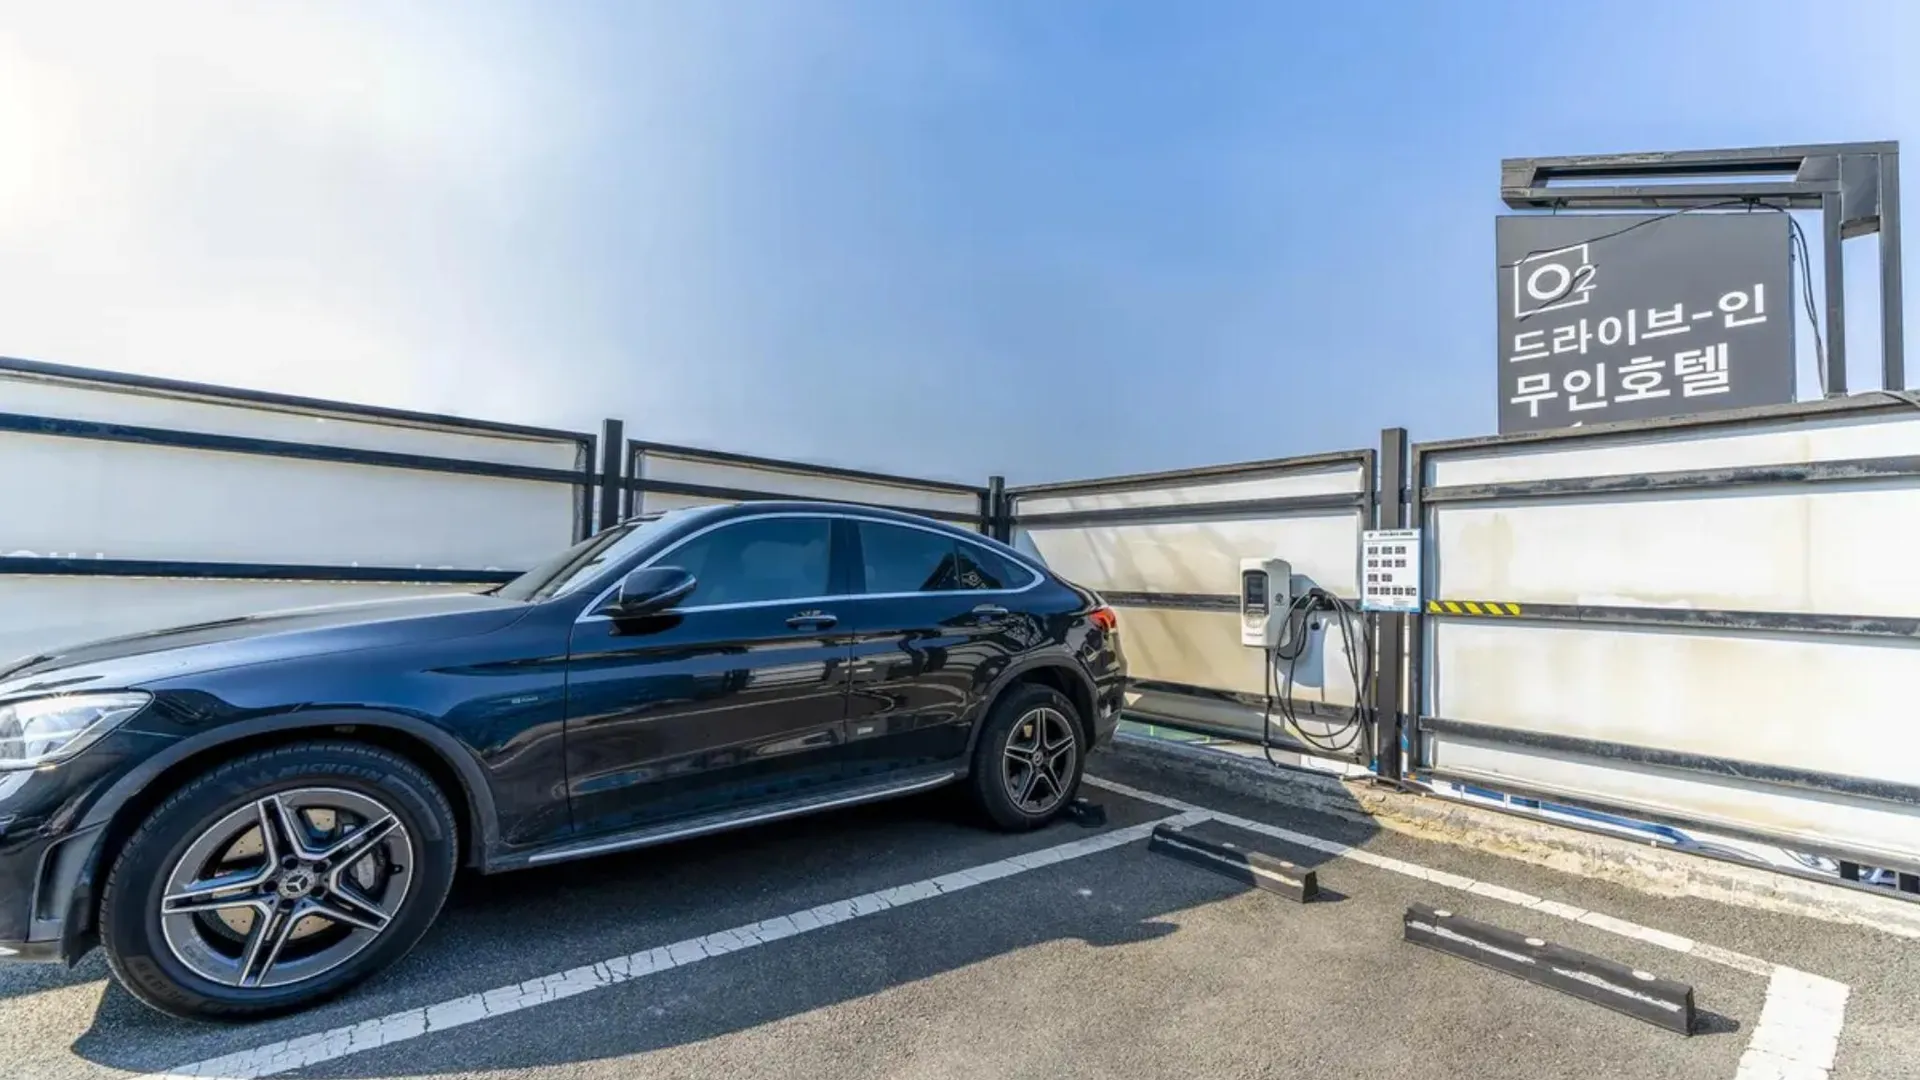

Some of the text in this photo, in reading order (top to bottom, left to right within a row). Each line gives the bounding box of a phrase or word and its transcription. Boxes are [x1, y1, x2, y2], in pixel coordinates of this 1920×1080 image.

[1510, 283, 1767, 363] 드라이브-인
[1510, 342, 1731, 417] 무인호텔
[279, 762, 382, 781] MICHELIN
